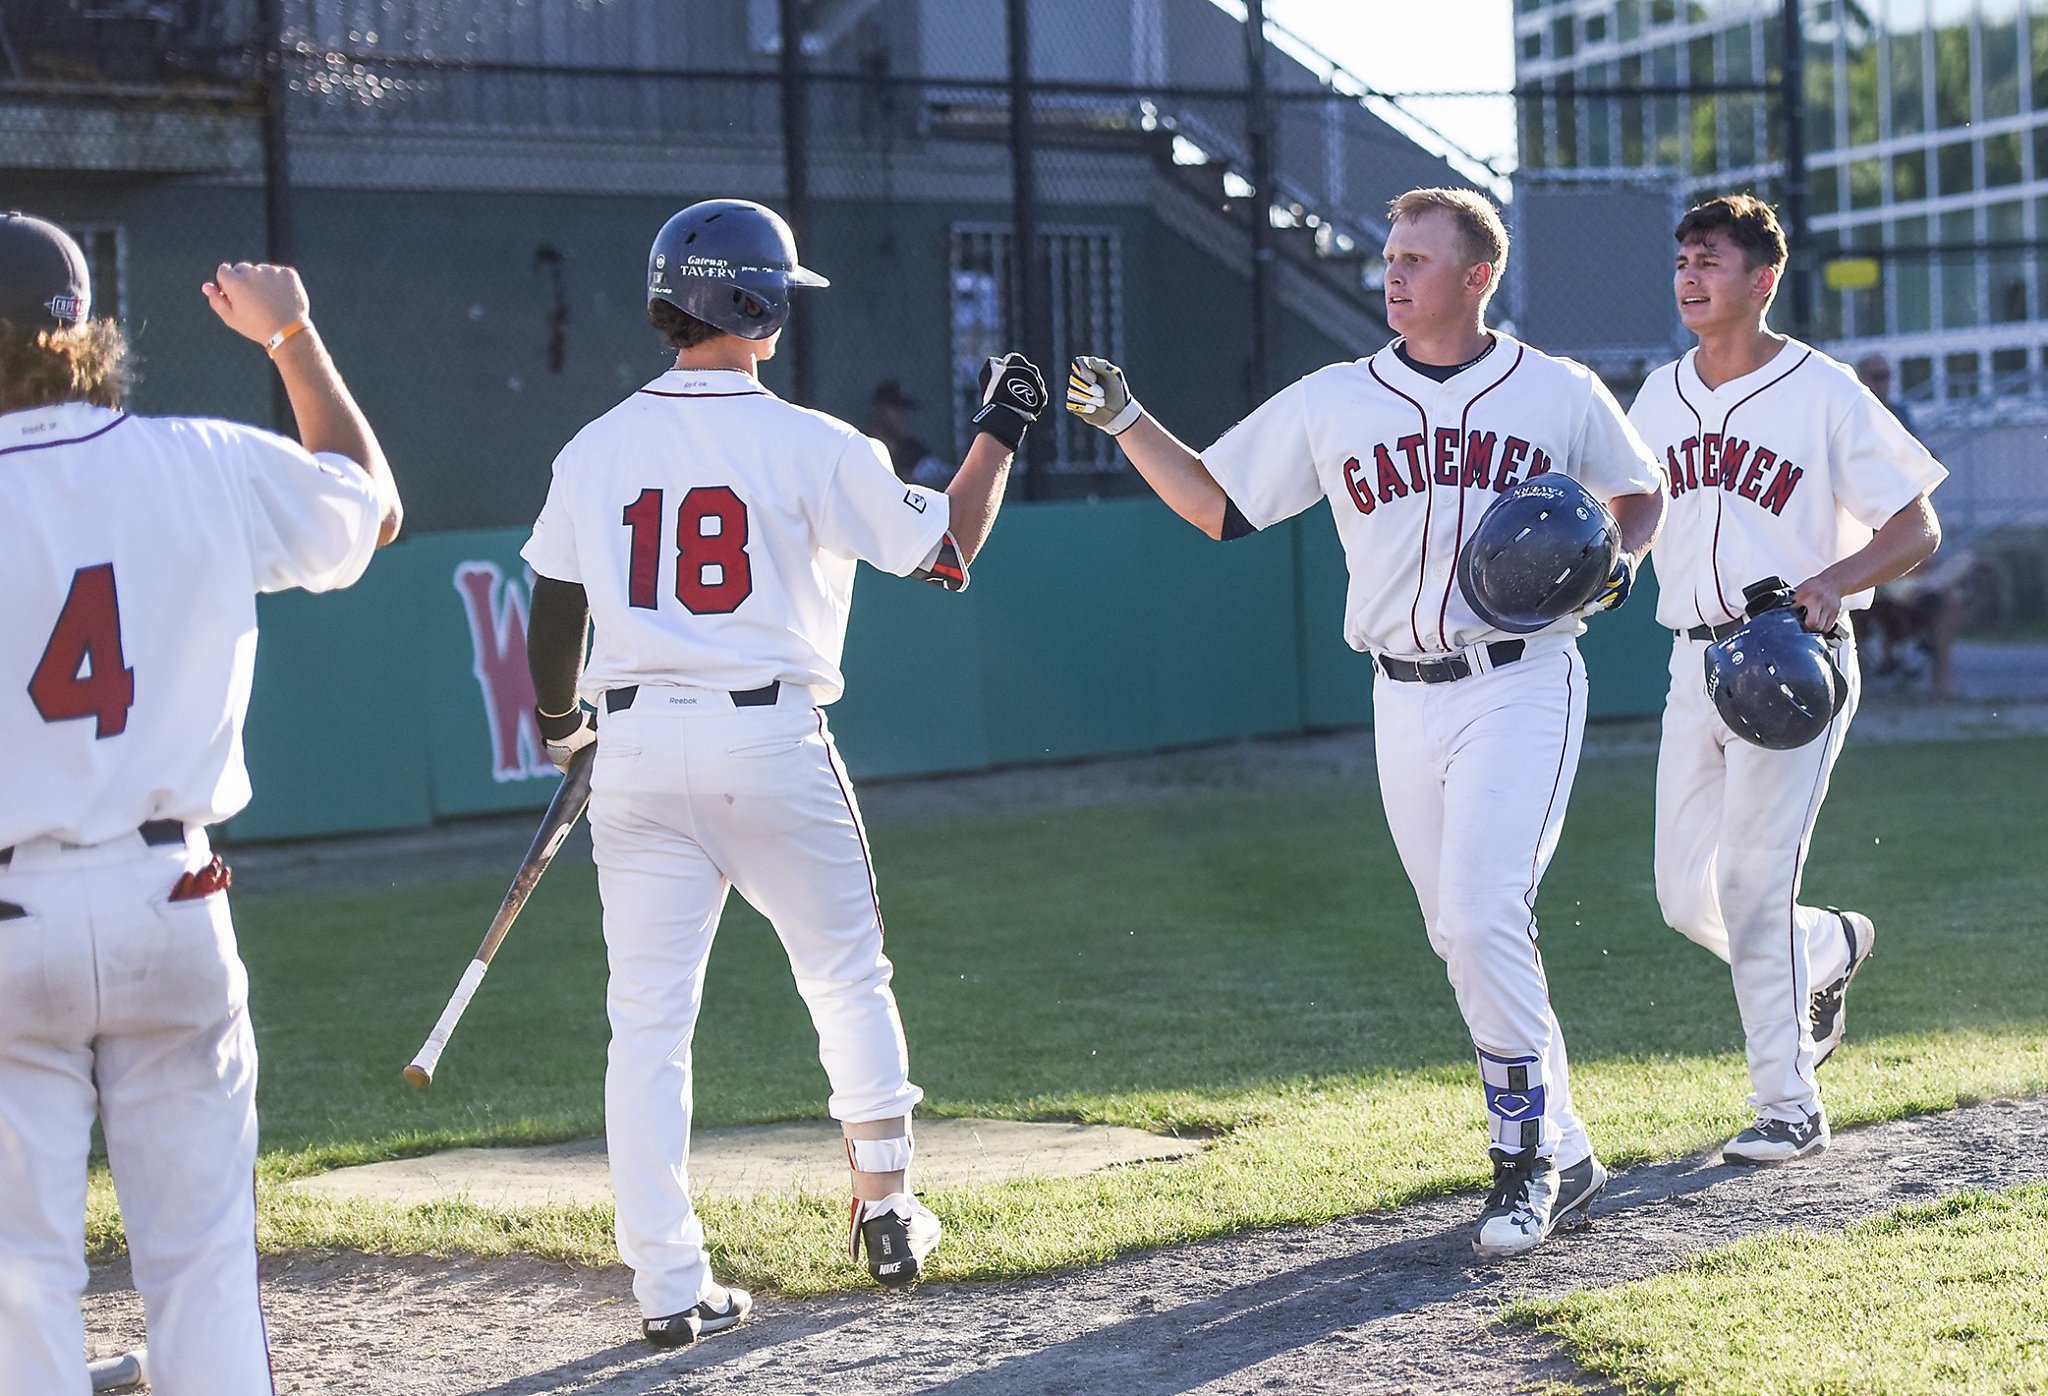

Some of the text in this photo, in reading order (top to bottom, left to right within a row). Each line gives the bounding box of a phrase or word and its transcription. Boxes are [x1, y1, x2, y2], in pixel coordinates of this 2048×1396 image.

[687, 255, 728, 269] Gateway
[680, 265, 736, 280] TAVERN
[1666, 433, 1804, 517] ATEMEN
[622, 485, 753, 615] 18
[27, 562, 134, 740] 4
[669, 697, 698, 705] Reebok
[879, 1261, 902, 1276] NIKE
[647, 1319, 671, 1331] NIKE
